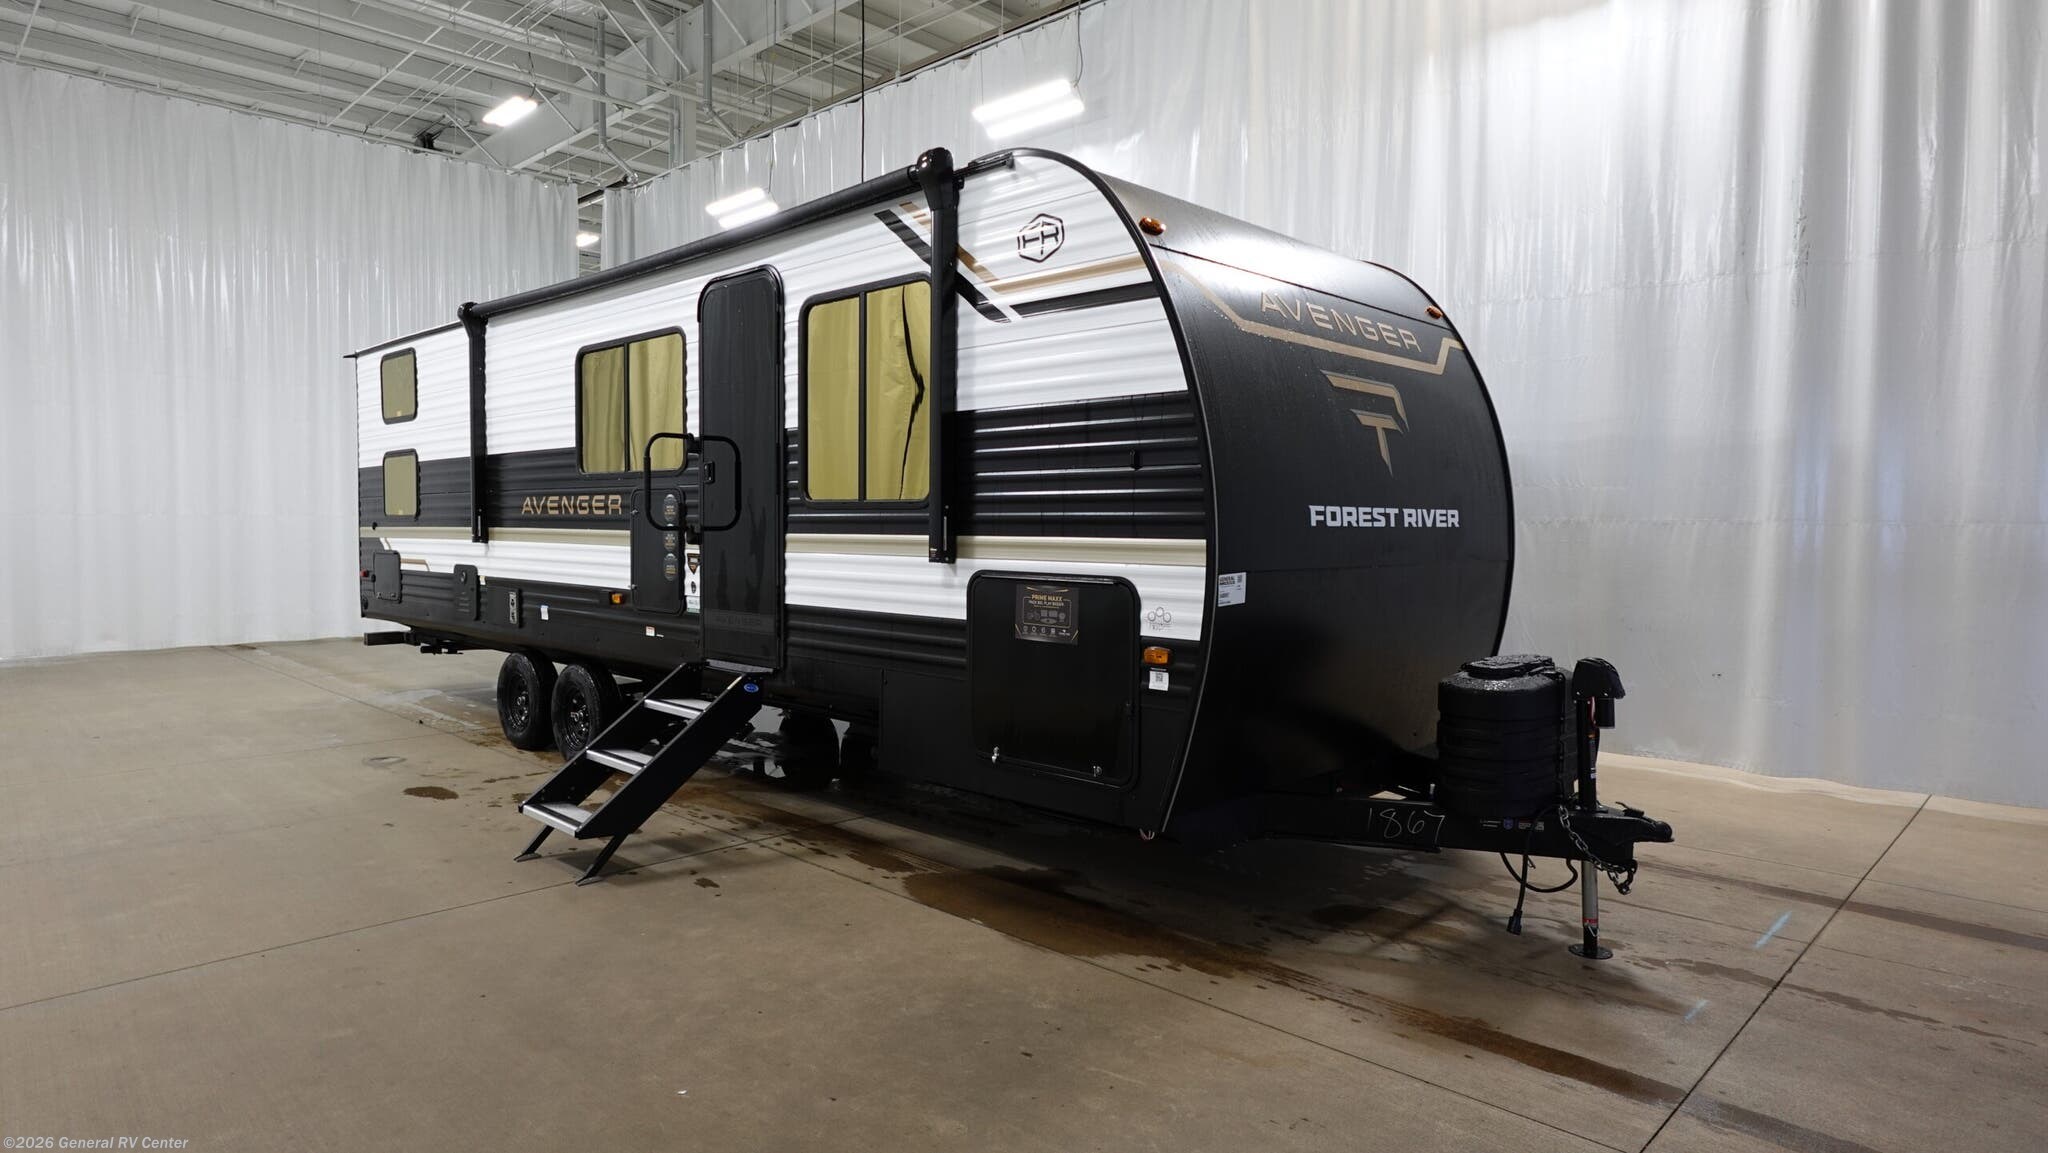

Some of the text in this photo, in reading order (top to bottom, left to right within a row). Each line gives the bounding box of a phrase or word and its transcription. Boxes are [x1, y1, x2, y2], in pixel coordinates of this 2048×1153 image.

[1261, 291, 1422, 353] AVENGER
[521, 495, 622, 515] AVENGER
[1309, 505, 1460, 528] FOREST RIVER
[1368, 807, 1446, 845] 1867
